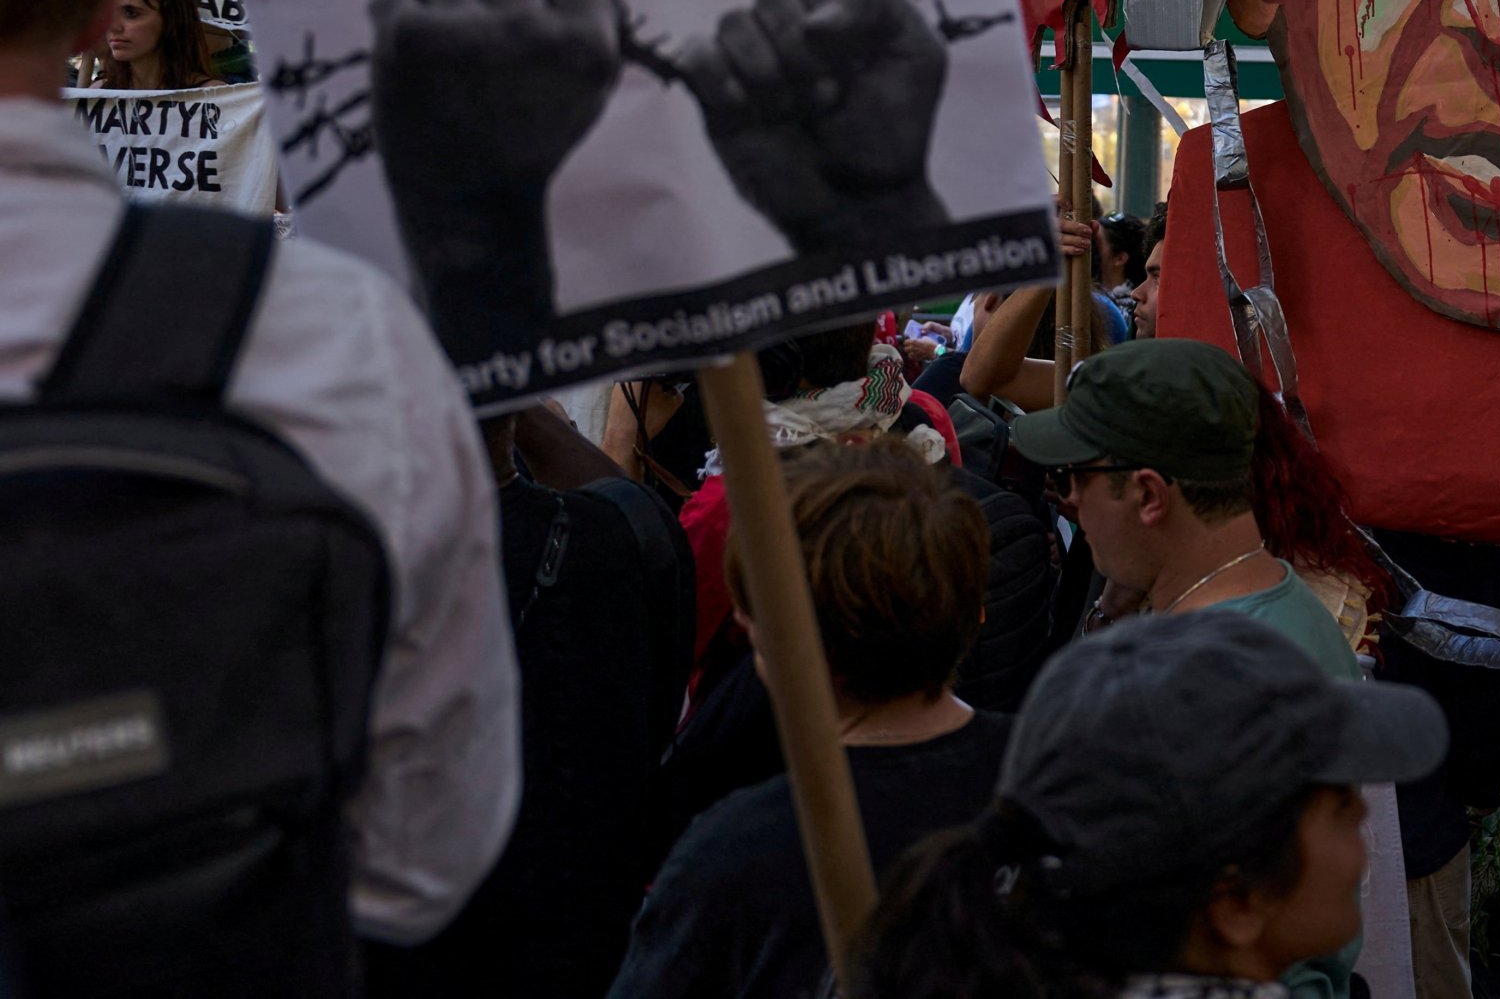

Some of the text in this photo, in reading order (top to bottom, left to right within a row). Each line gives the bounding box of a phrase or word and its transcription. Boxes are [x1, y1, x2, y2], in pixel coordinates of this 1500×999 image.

[76, 98, 221, 139] MARTYR
[538, 337, 596, 374] for
[603, 291, 783, 356] Socialism
[787, 266, 857, 312] and
[863, 236, 1046, 294] Liberation
